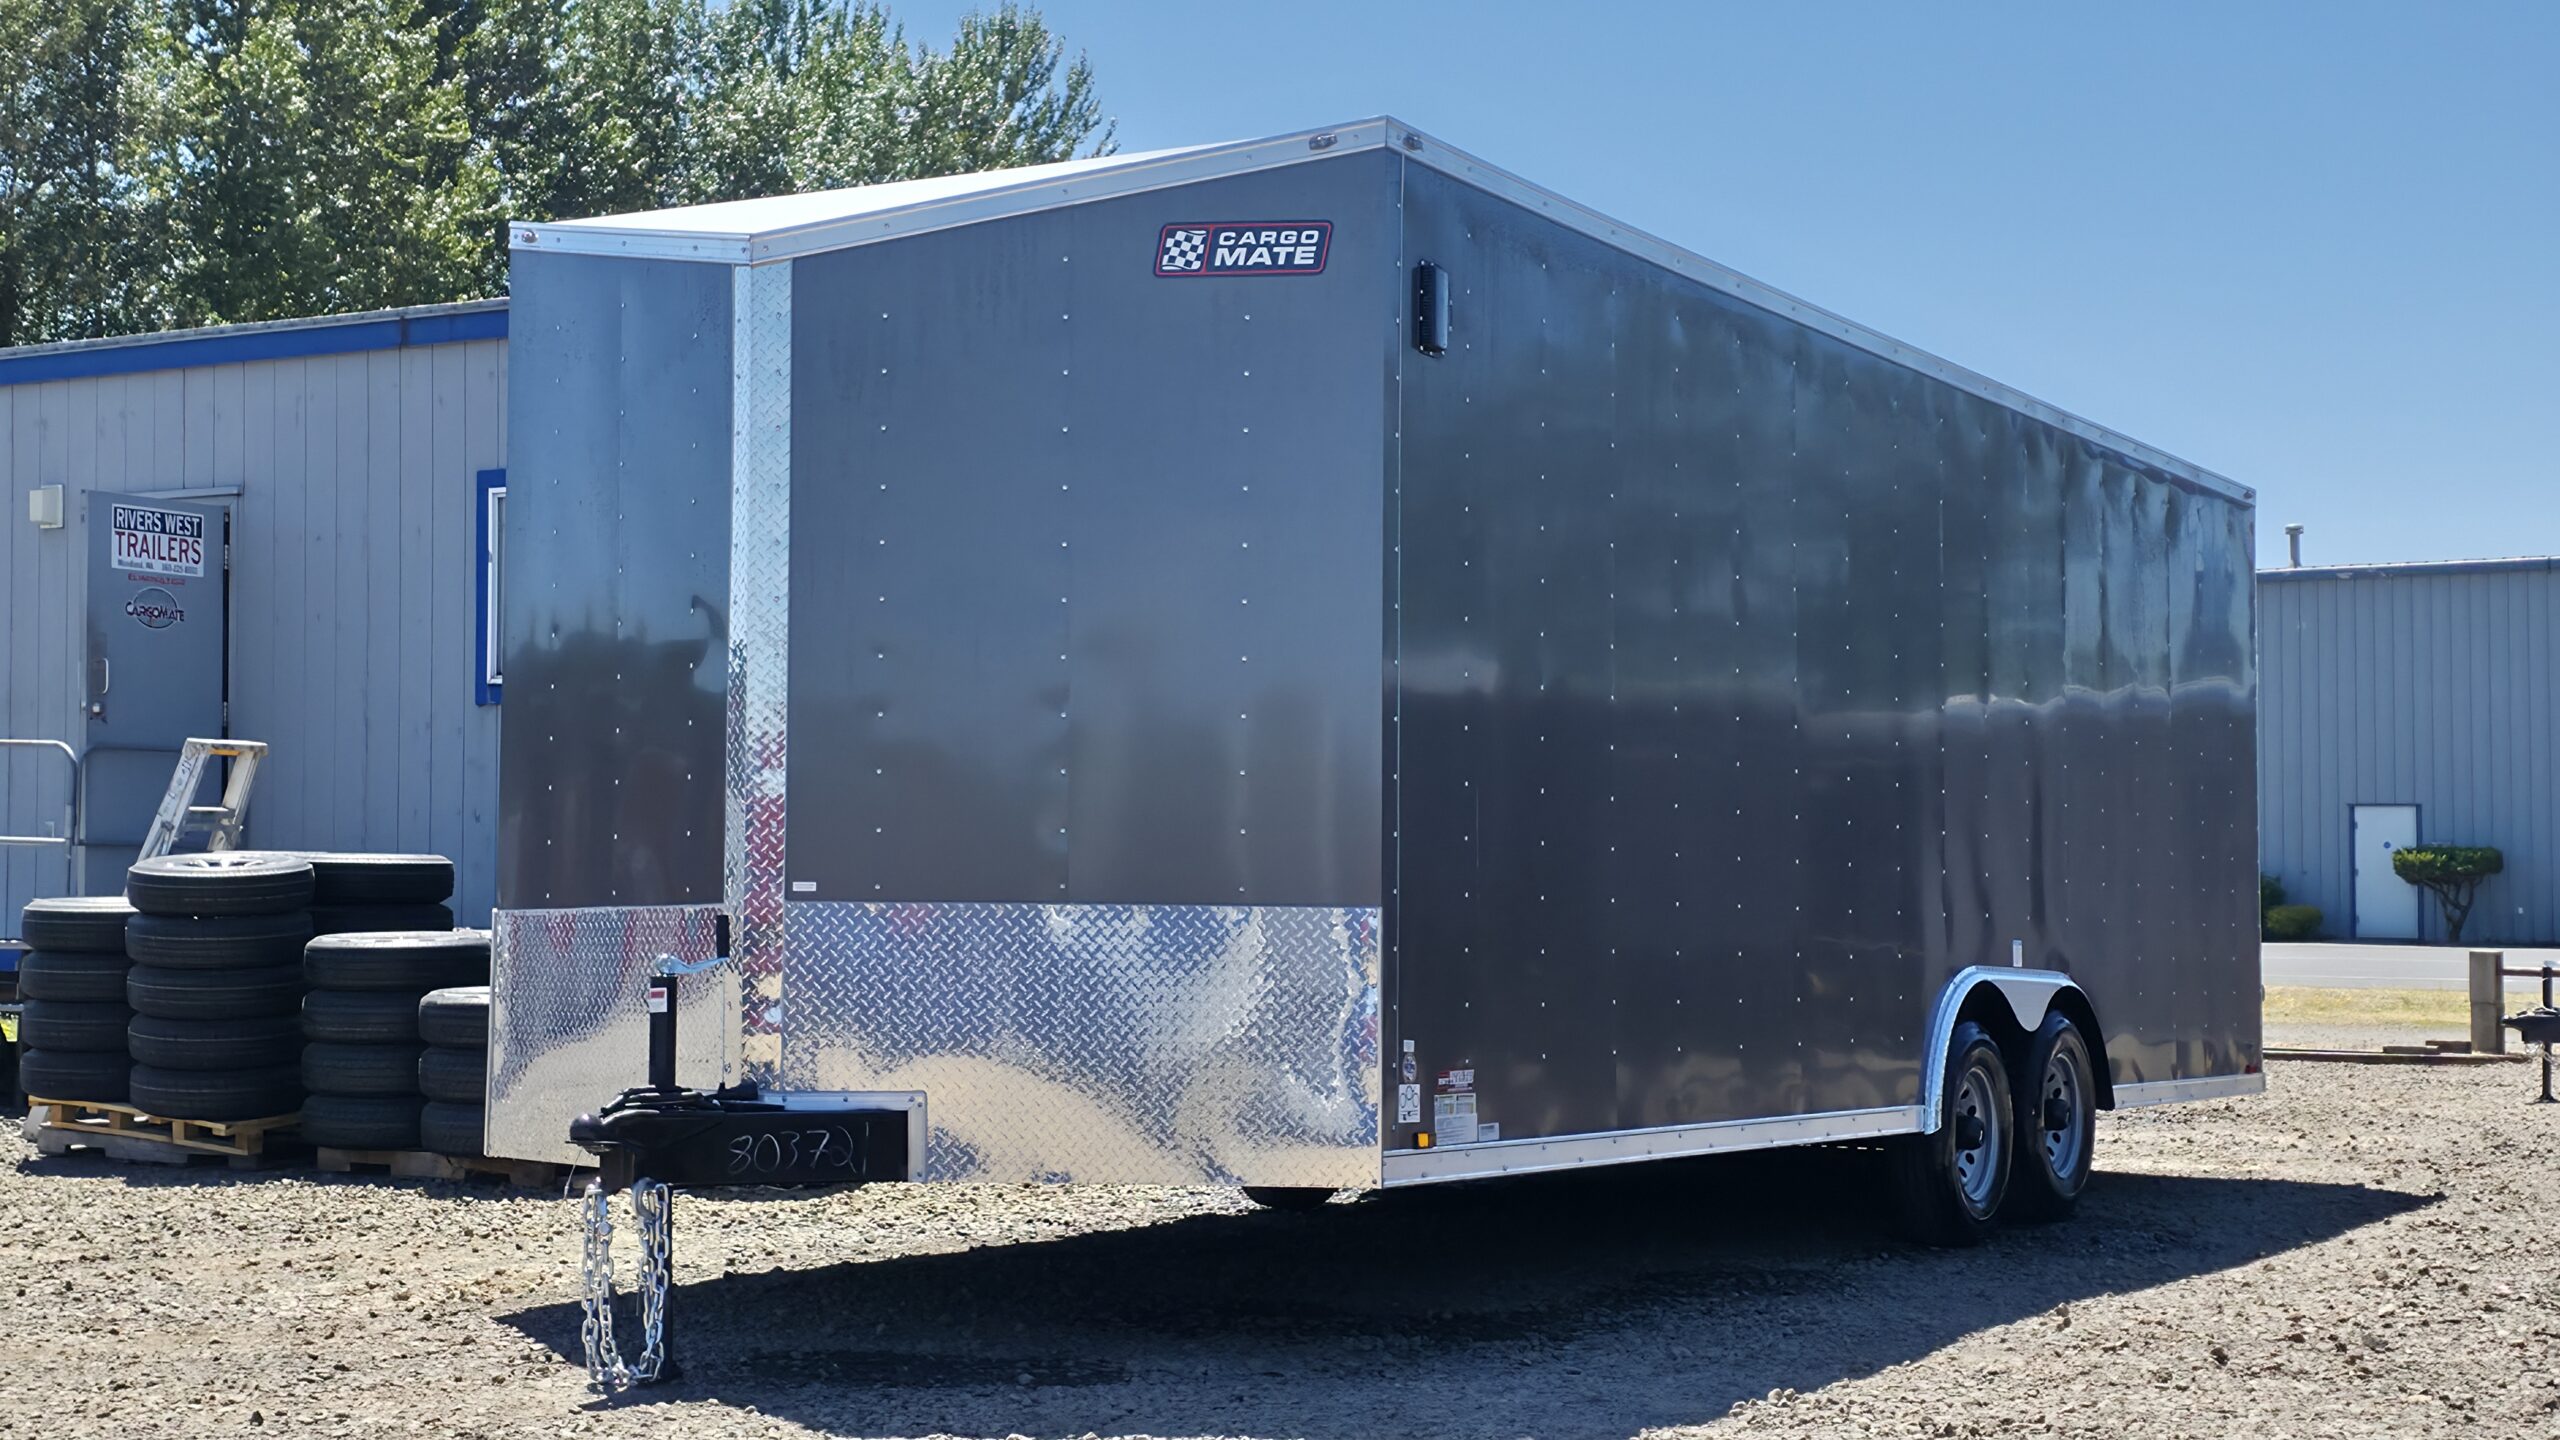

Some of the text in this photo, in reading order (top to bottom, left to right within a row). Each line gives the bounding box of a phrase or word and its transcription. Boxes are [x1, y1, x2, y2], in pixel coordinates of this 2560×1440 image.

[1218, 230, 1319, 246] CARGO
[1214, 245, 1317, 267] MATE
[116, 508, 200, 537] RIVERS WEST
[115, 530, 202, 565] TRAILERS
